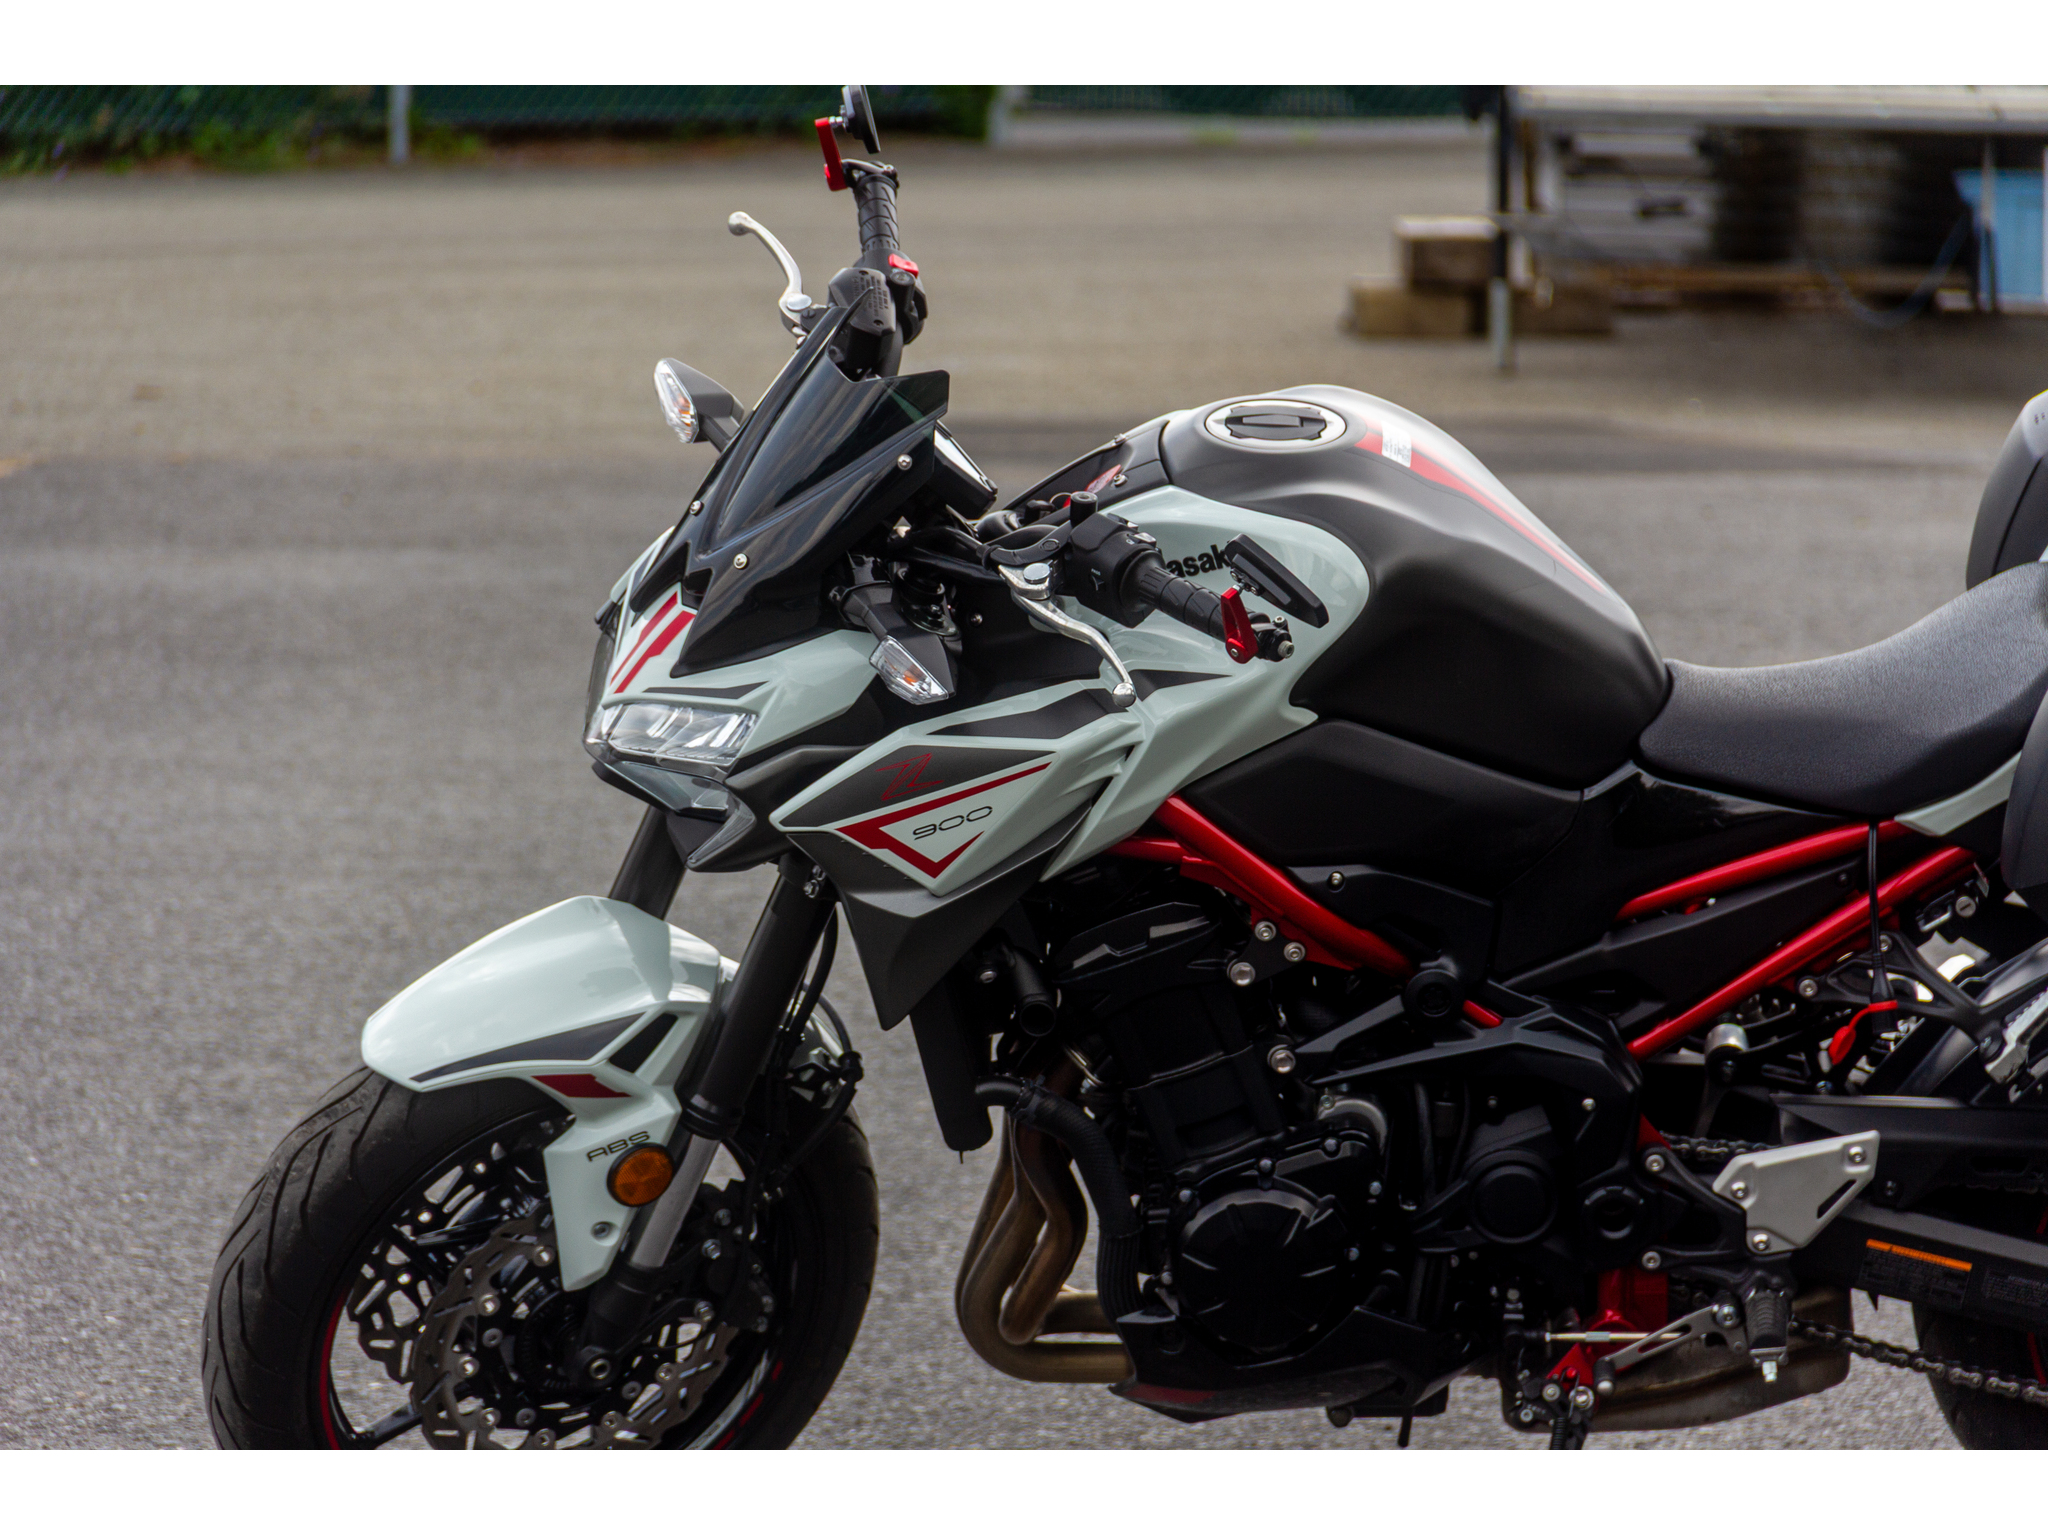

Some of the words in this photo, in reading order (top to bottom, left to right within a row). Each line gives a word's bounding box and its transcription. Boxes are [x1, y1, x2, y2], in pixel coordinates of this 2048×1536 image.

[1166, 544, 1231, 578] asak
[912, 805, 993, 841] 900
[586, 1130, 651, 1162] ABS
